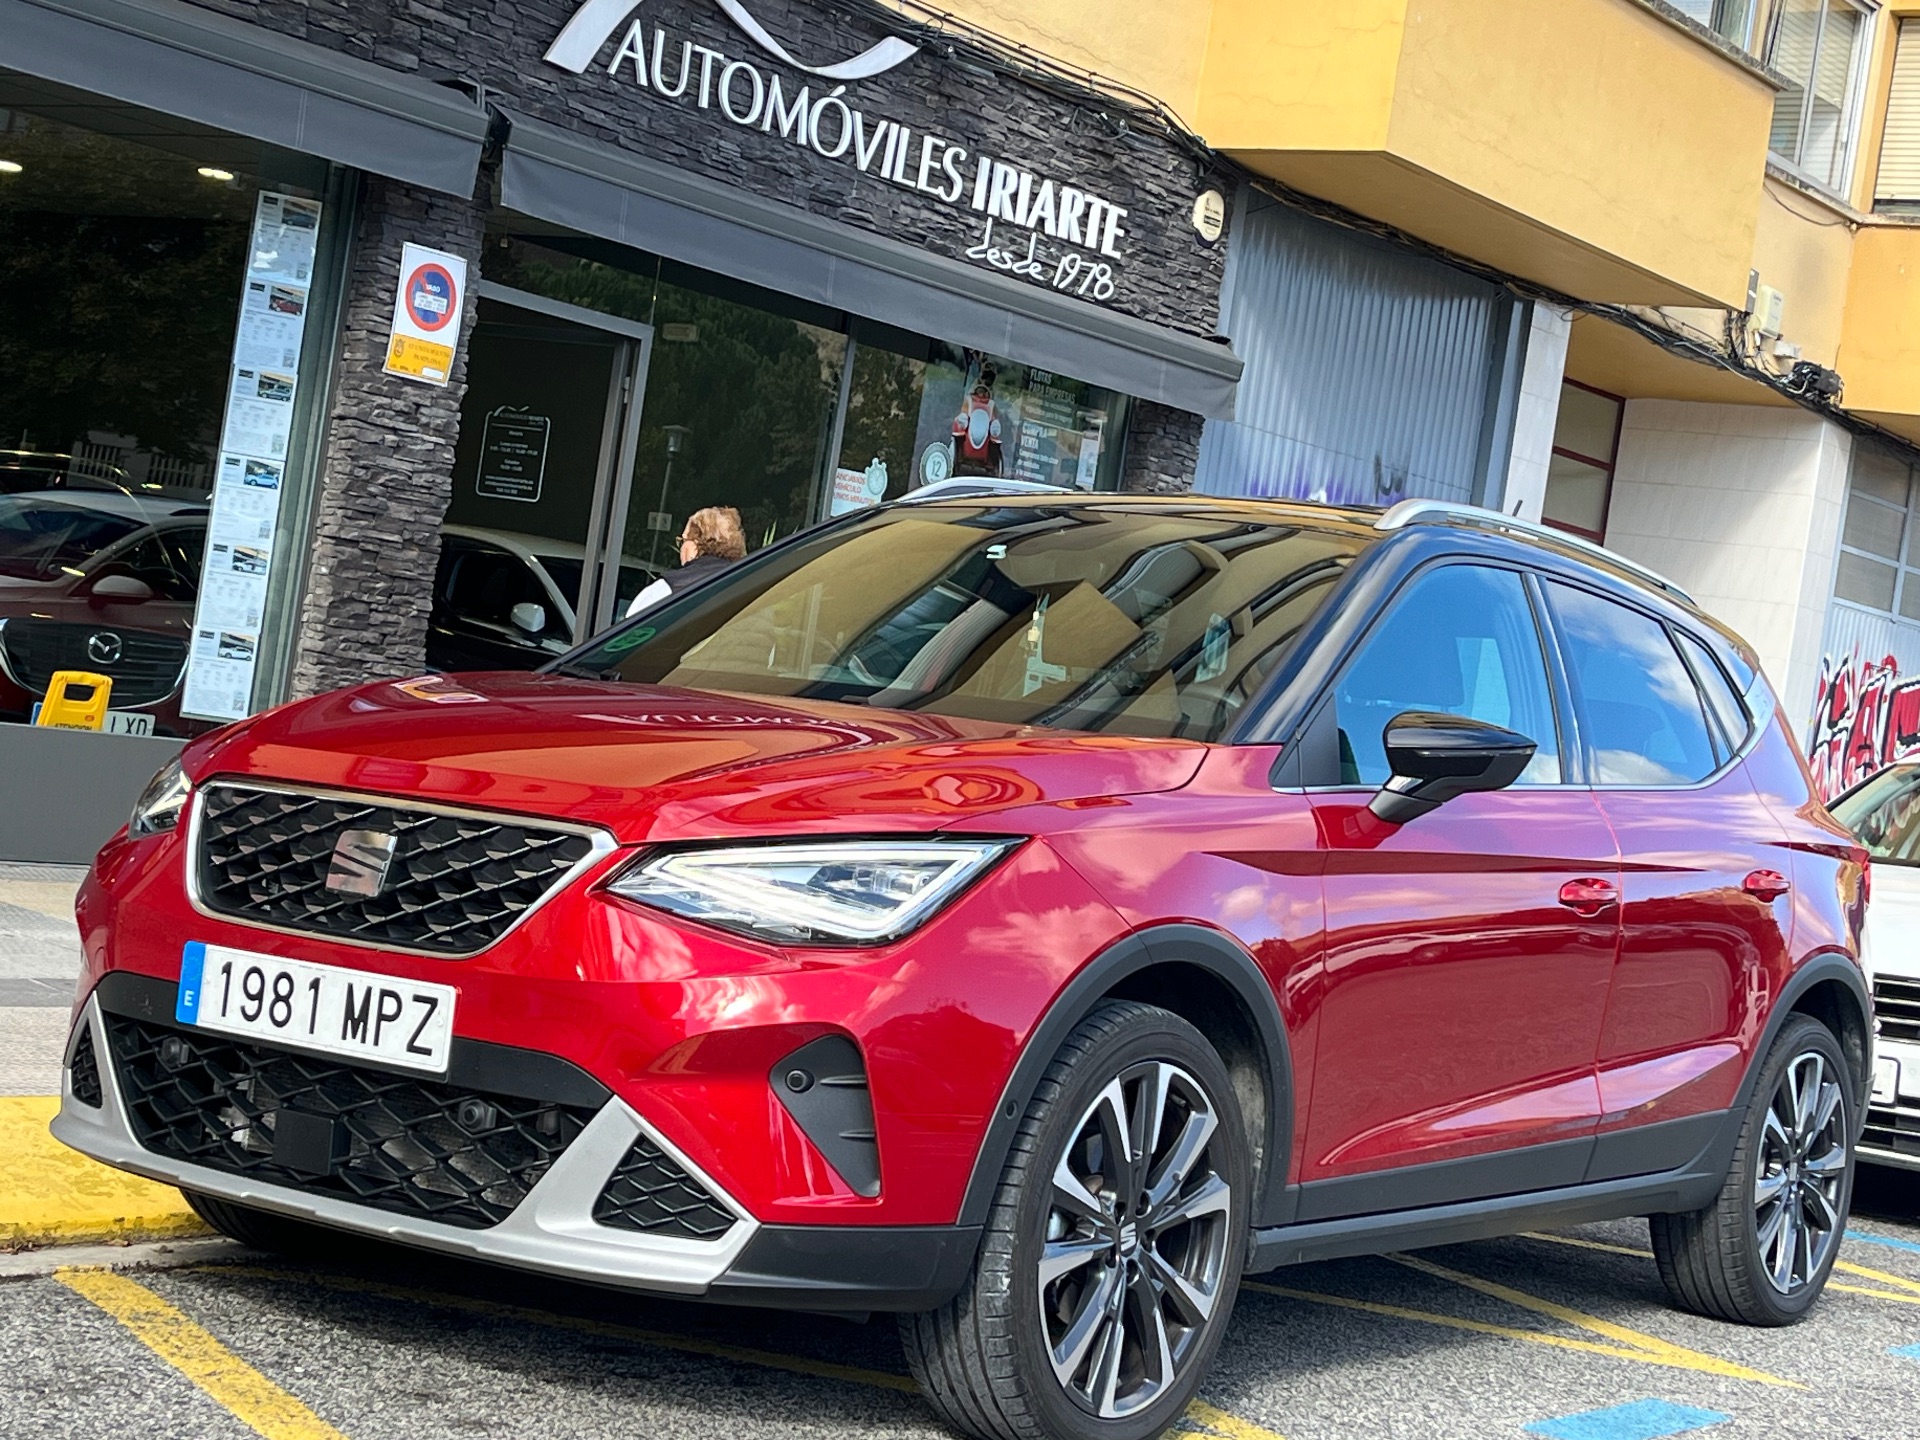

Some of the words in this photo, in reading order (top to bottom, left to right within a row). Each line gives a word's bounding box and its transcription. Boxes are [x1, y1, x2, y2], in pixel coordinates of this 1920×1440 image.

[606, 18, 968, 202] AUTOMÓVILES
[971, 156, 1128, 259] IRIARTE
[965, 217, 1045, 280] desde
[1052, 253, 1115, 300] 1978
[931, 460, 942, 477] 12
[184, 990, 194, 1007] E
[221, 961, 322, 1035] 1981
[341, 982, 439, 1057] MPZ
